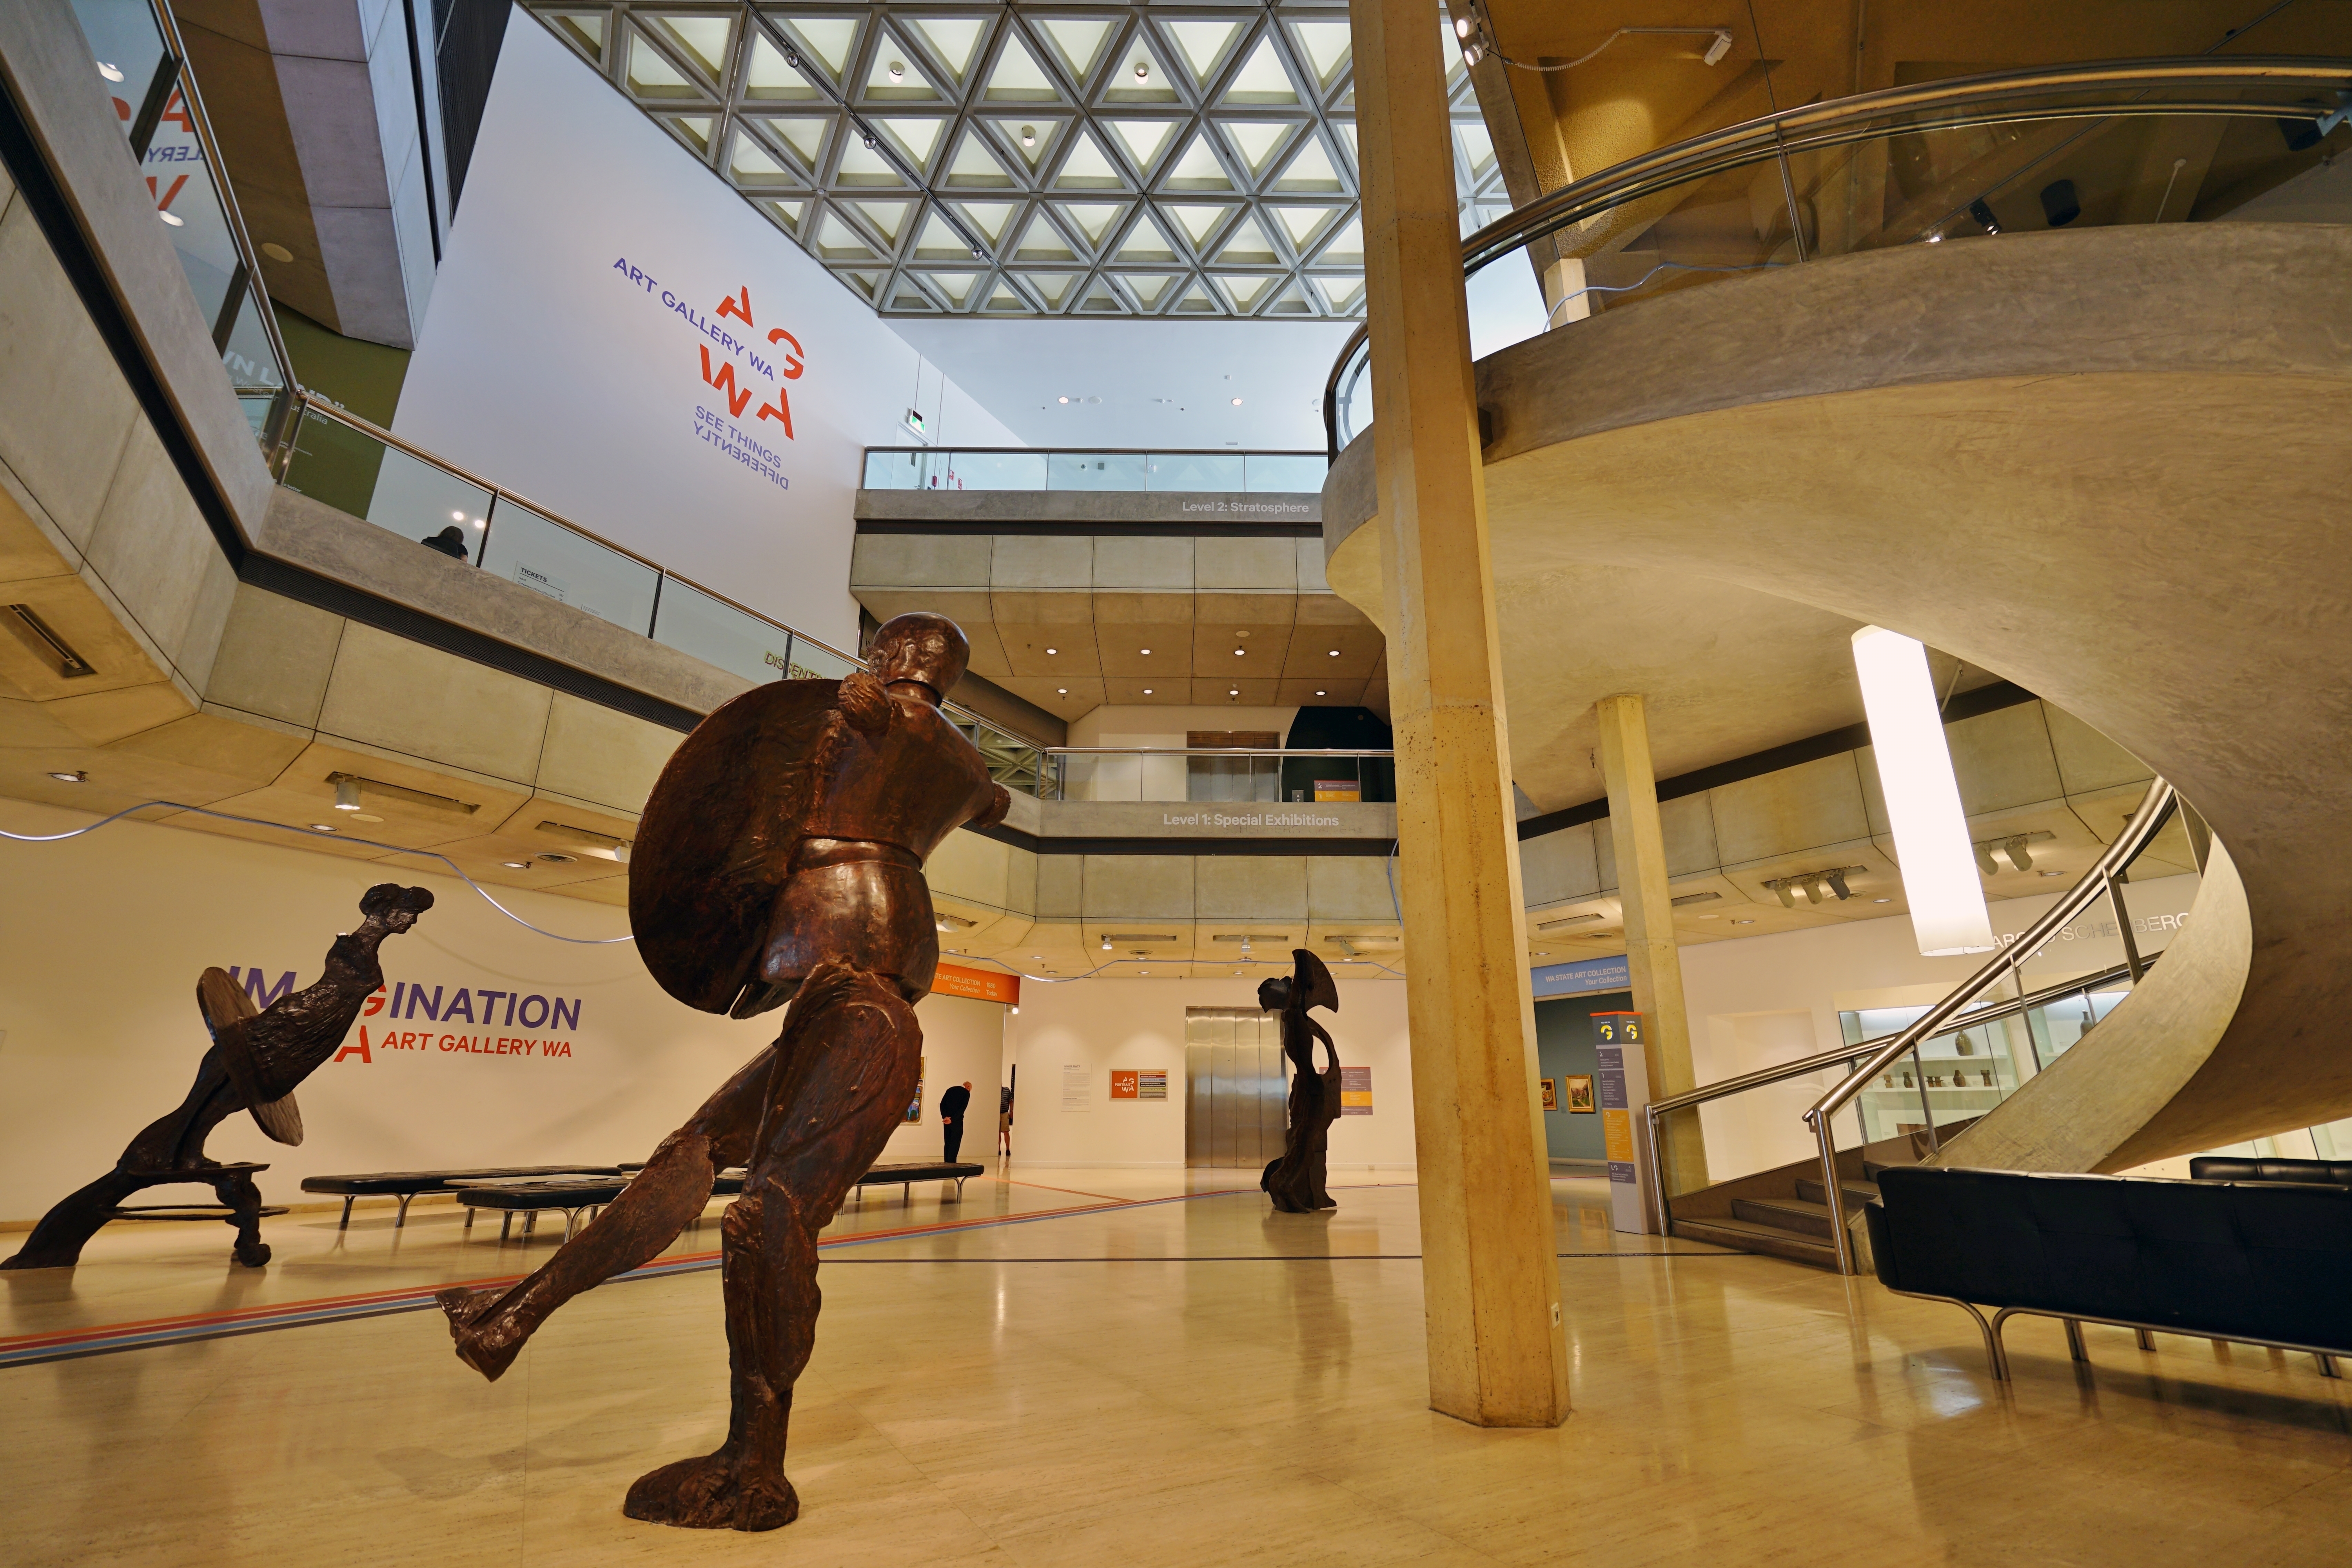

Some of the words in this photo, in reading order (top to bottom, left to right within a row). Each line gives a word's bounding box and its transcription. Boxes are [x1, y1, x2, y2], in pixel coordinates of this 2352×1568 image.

[613, 257, 657, 293] ART
[662, 291, 744, 356] GALLERY
[750, 351, 774, 381] WA
[695, 405, 724, 432] SEE
[728, 425, 781, 468] THINGS
[1183, 501, 1214, 512] Level
[1217, 502, 1228, 512] 2:
[1230, 502, 1309, 514] Stratosphere
[521, 567, 547, 582] TICKETS
[1164, 814, 1198, 825] Level
[1202, 814, 1211, 825] 1:
[1214, 814, 1261, 828] Special
[1265, 814, 1339, 826] Exhibitions
[2062, 913, 2189, 941] SCHEBER
[1588, 966, 1626, 977] COLLECTION
[953, 976, 980, 986] COLLECTION
[1599, 975, 1627, 984] Collection
[960, 985, 980, 994] Collection
[986, 989, 998, 998] Today
[381, 1032, 434, 1051] ART
[439, 1034, 537, 1056] GALLERY
[543, 1040, 572, 1058] WA
